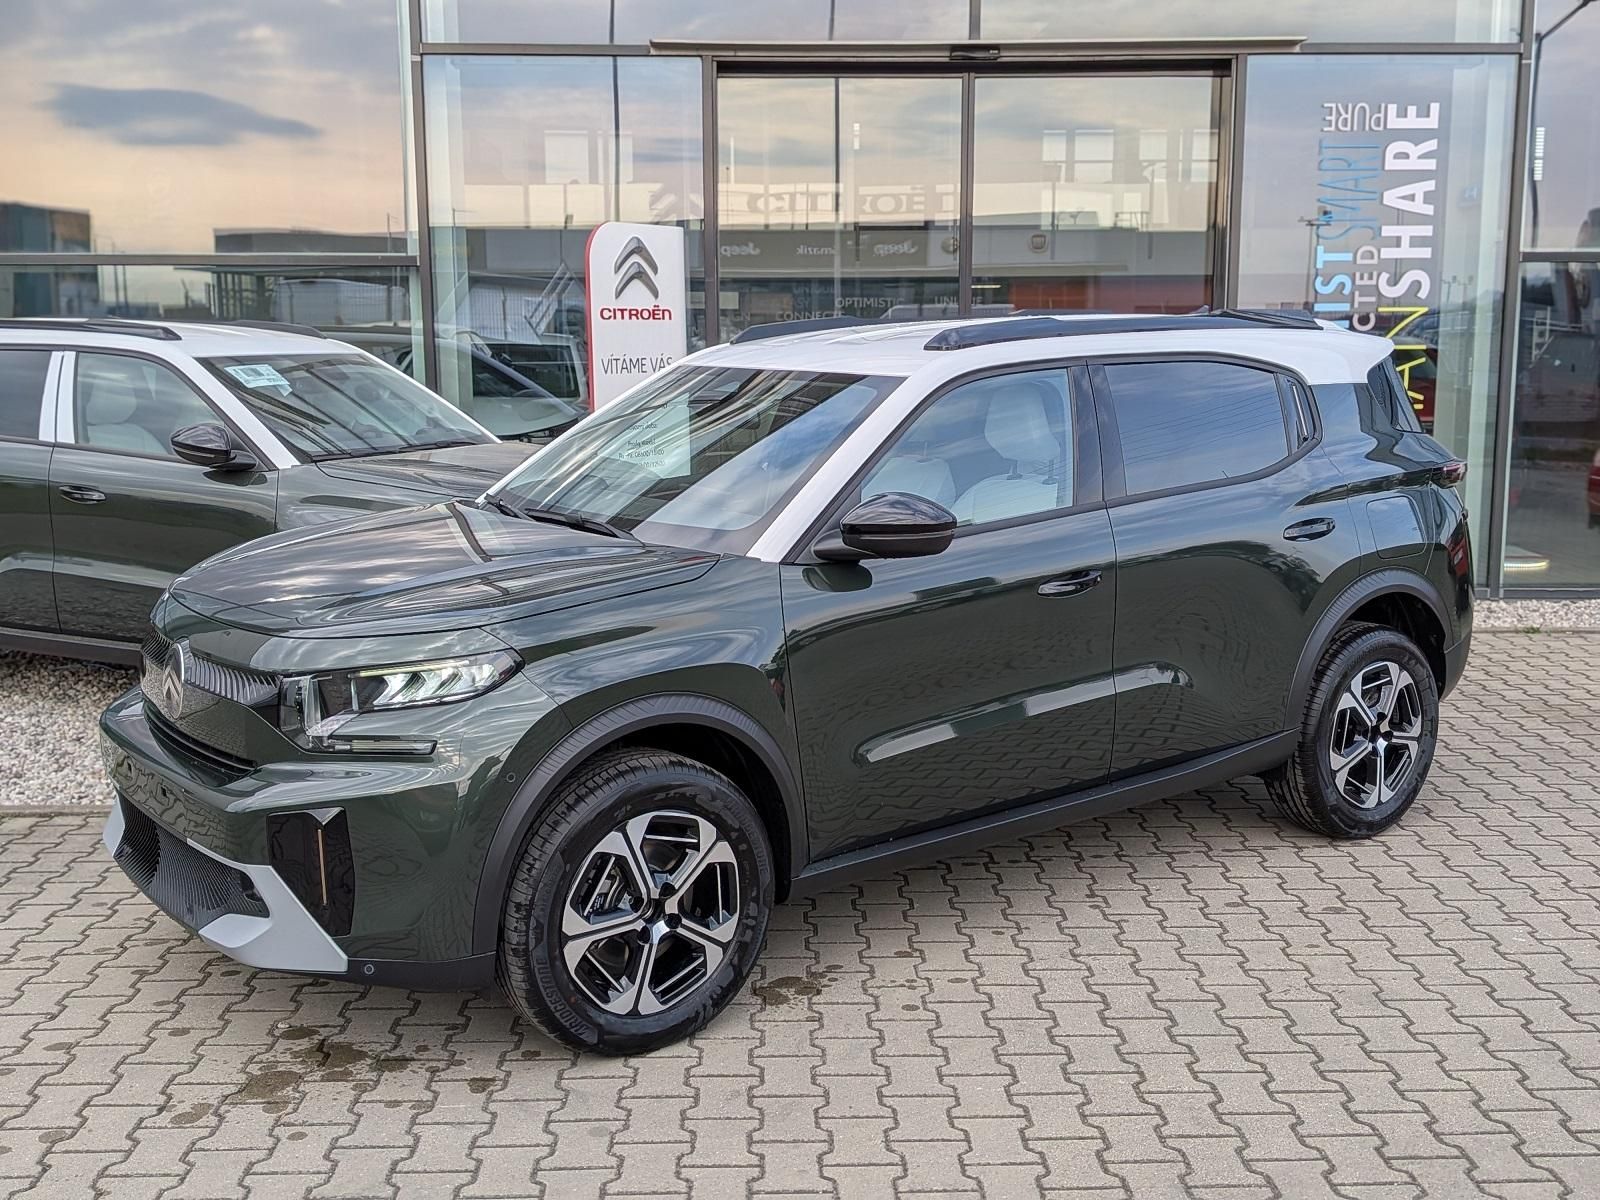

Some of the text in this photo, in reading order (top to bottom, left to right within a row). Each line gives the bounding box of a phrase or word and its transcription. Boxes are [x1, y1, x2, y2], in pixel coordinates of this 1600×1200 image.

[1322, 102, 1385, 132] PURE
[1316, 138, 1381, 241] SMART
[1377, 102, 1440, 300] SHARE
[599, 304, 673, 321] CITROËN
[600, 353, 648, 375] VÍTÁME
[1377, 306, 1430, 410] AN
